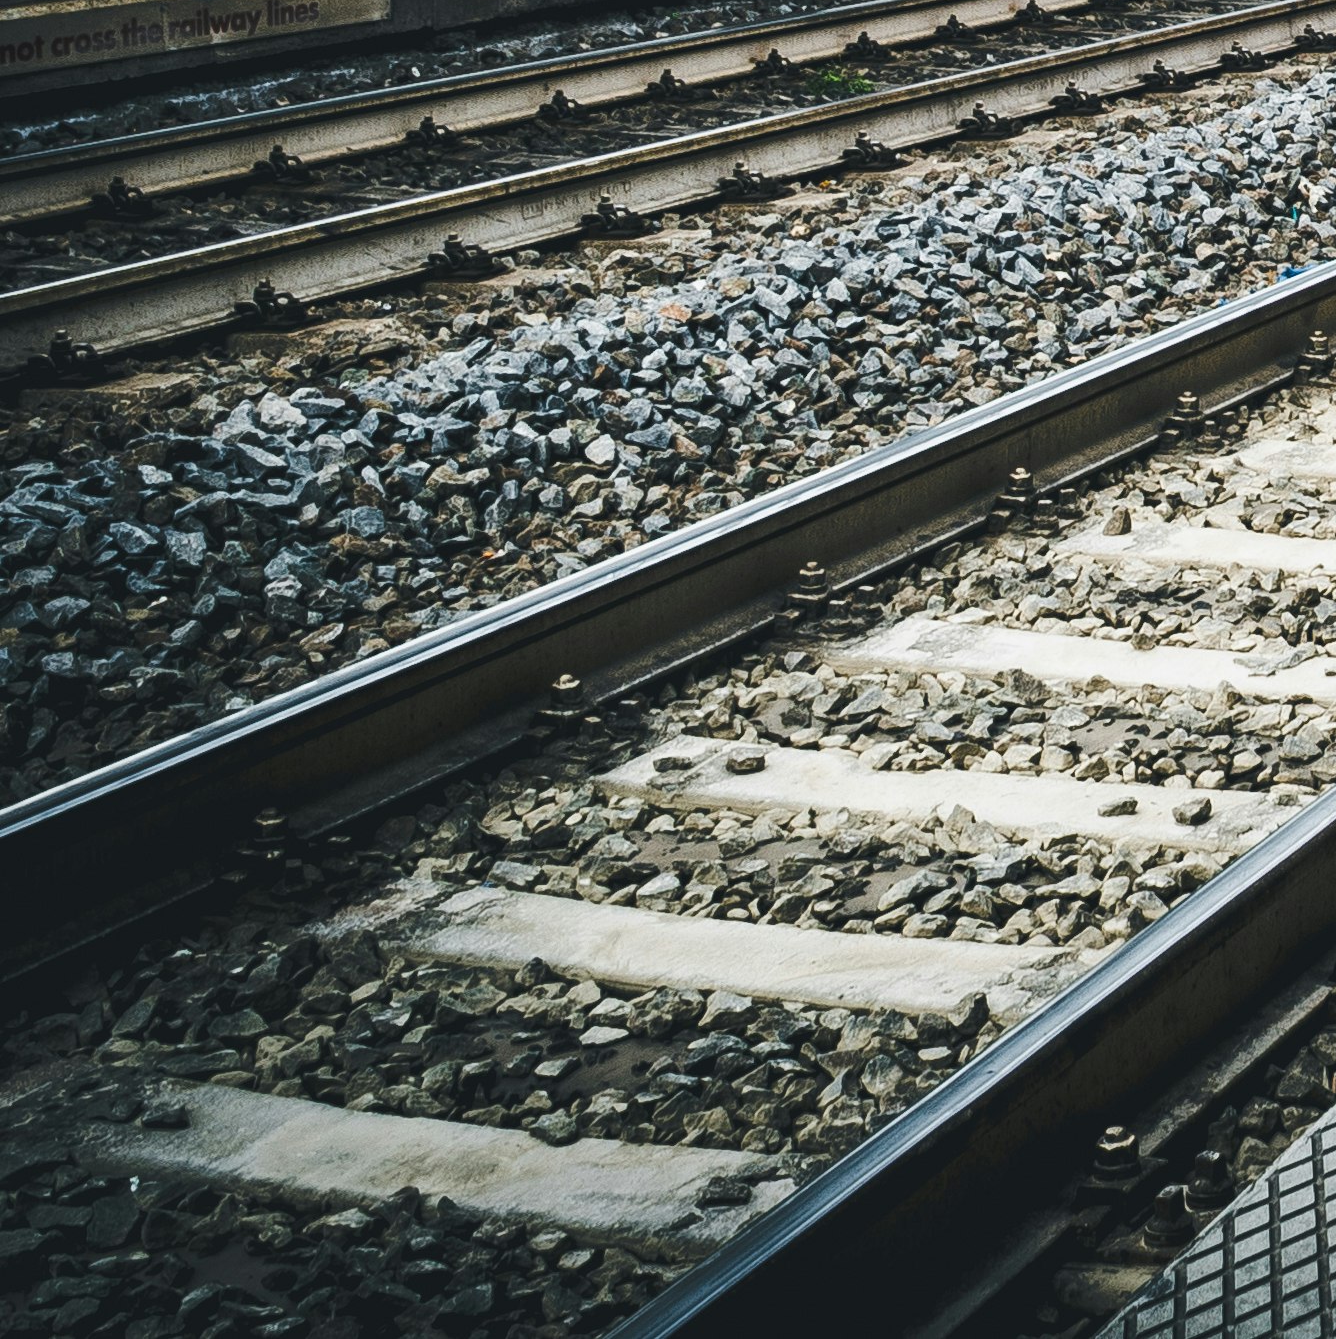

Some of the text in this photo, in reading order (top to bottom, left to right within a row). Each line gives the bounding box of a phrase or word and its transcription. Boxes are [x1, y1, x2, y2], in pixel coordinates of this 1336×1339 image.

[0, 34, 45, 65] not
[52, 29, 117, 58] cross
[121, 17, 164, 48] the
[168, 7, 262, 38] railway
